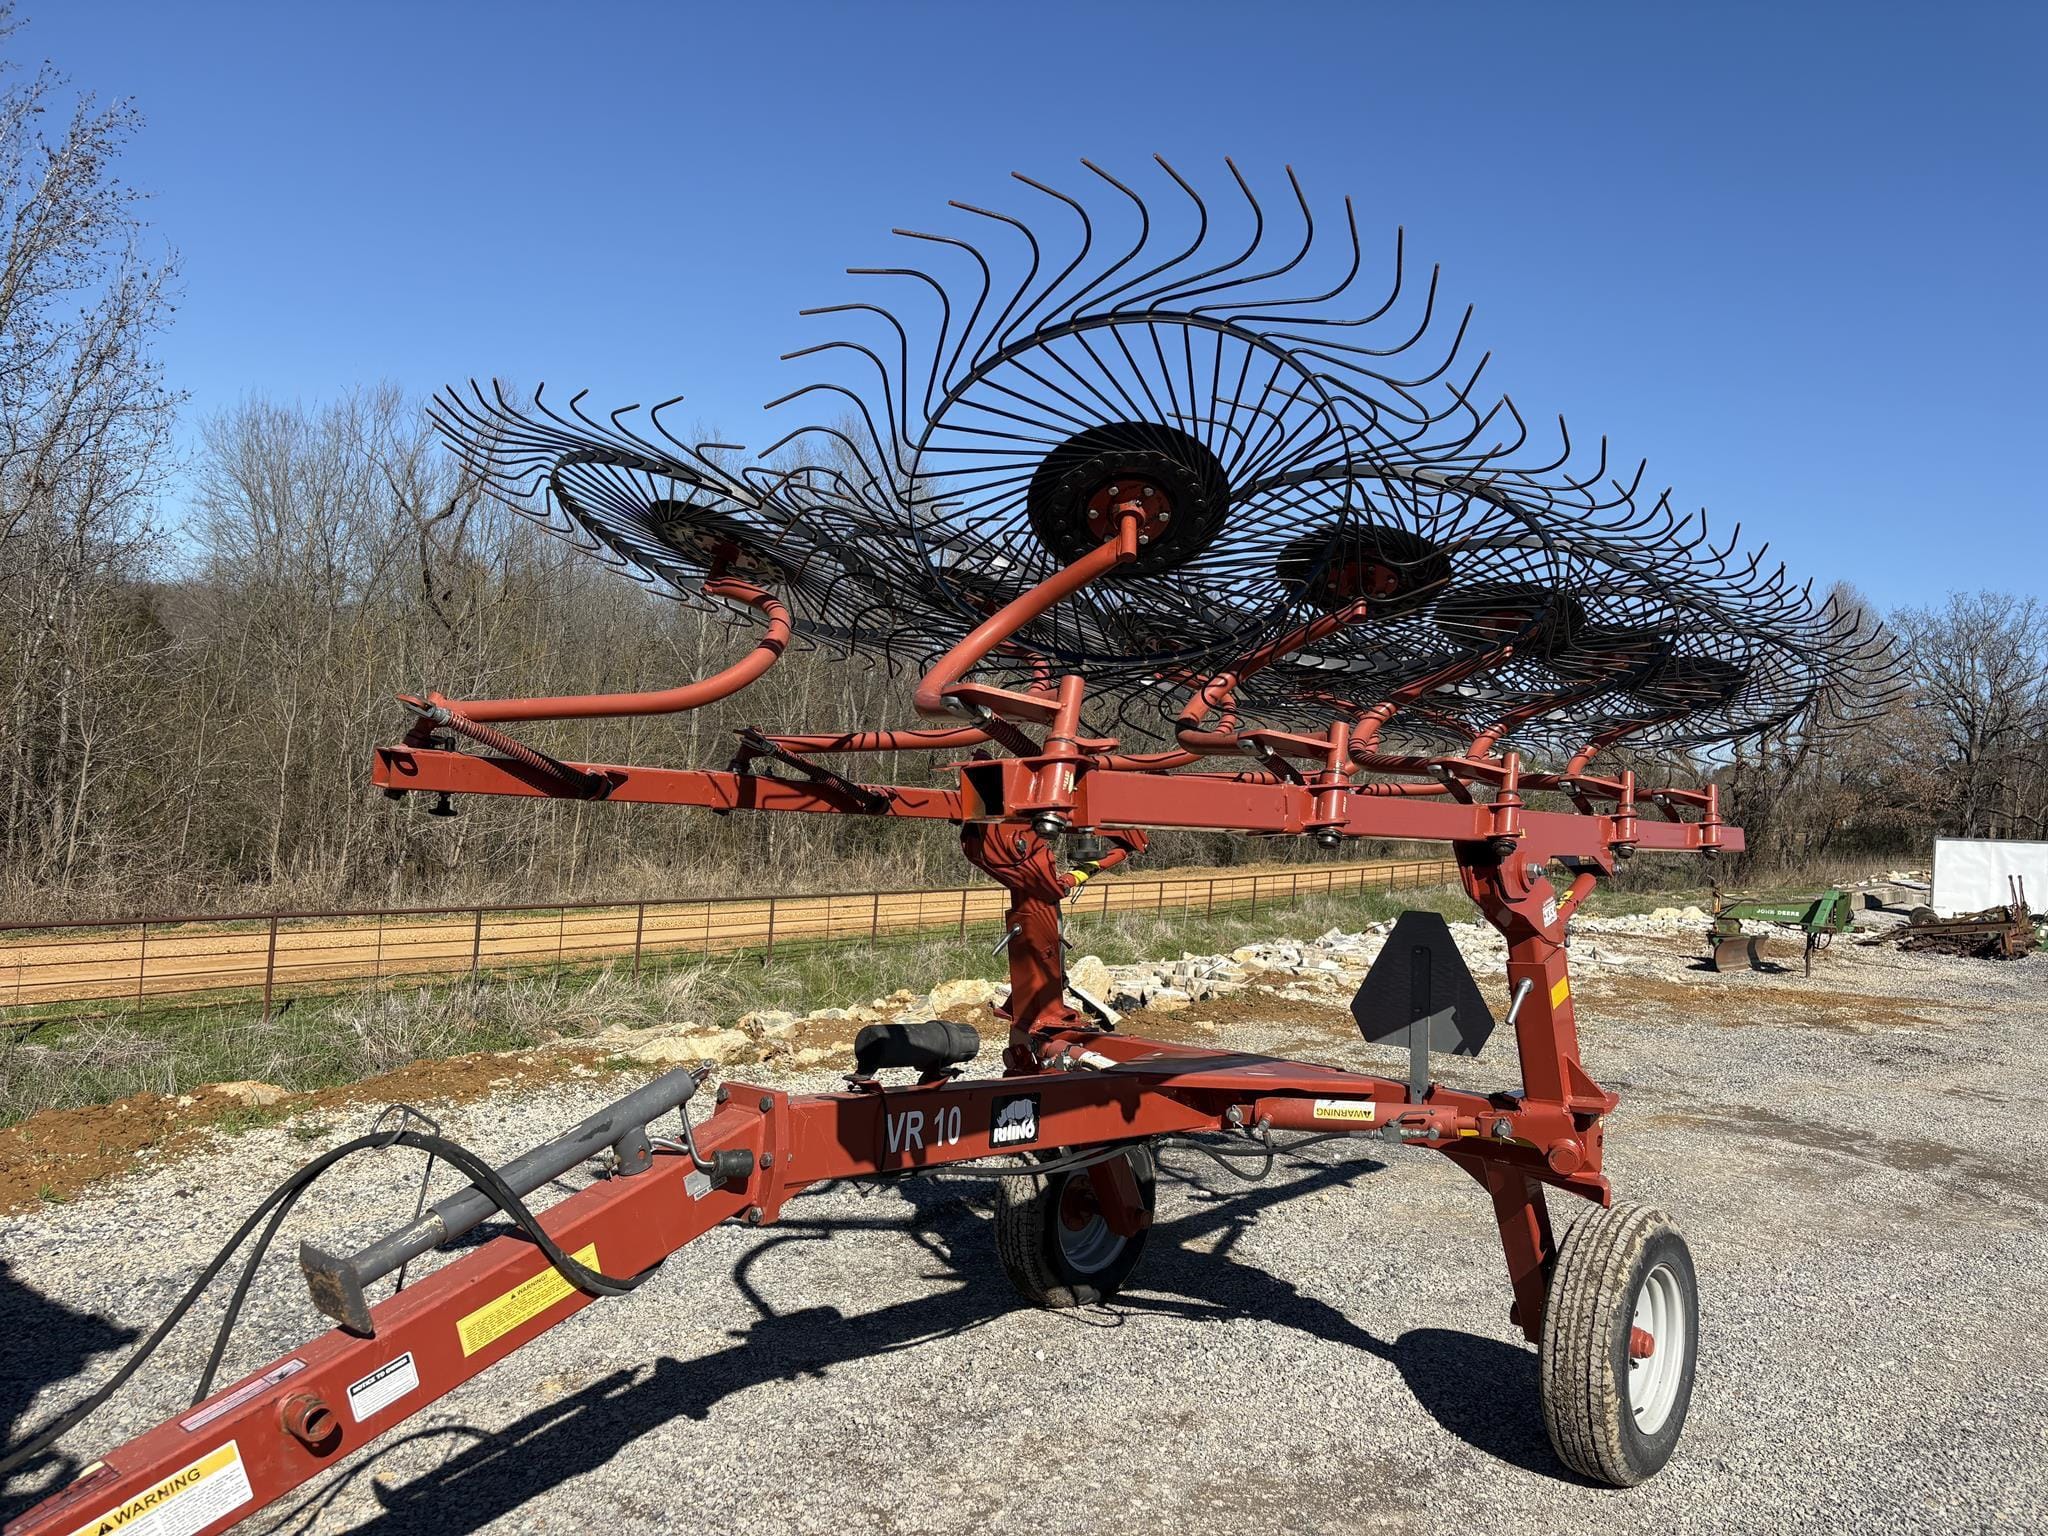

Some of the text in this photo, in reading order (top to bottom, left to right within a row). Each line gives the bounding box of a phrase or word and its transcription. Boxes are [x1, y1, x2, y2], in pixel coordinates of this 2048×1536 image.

[887, 1106, 962, 1153] VR 10
[993, 1118, 1036, 1143] RHINO
[1316, 1107, 1364, 1118] WARNING
[113, 1468, 201, 1525] WARNING
